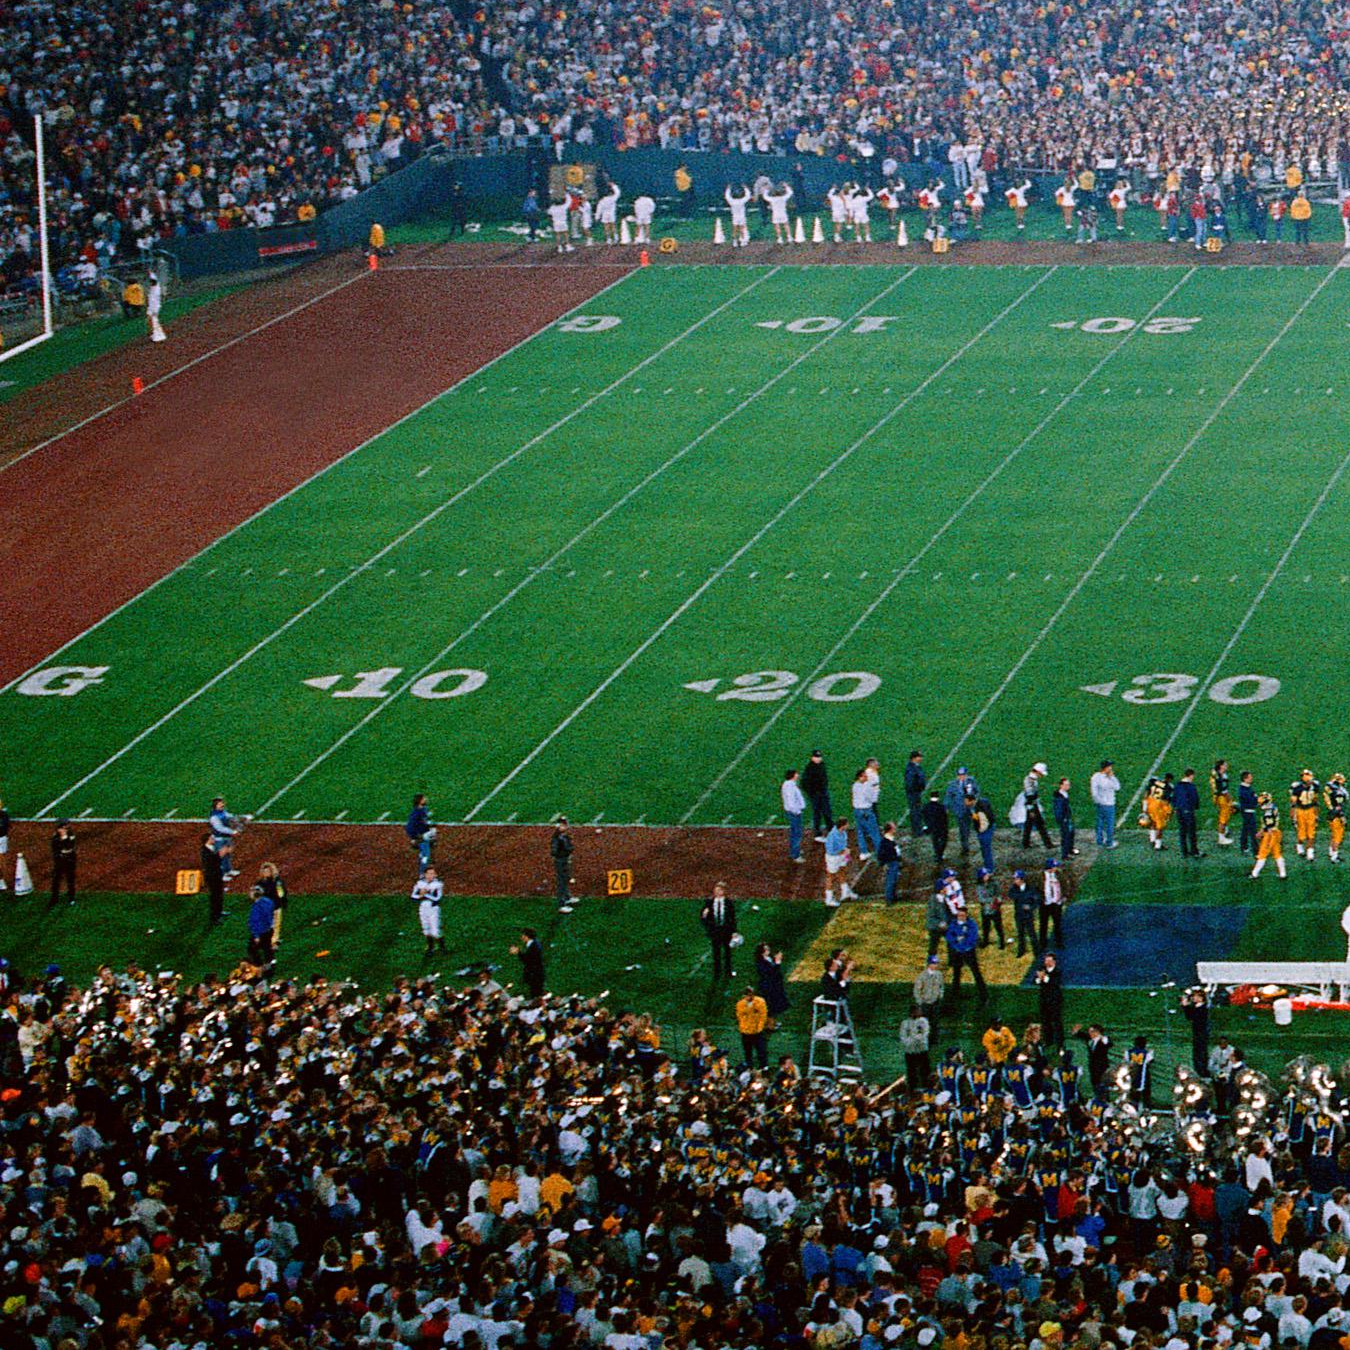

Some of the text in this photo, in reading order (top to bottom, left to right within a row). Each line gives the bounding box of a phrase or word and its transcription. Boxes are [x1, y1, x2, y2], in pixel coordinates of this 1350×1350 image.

[555, 315, 621, 333] G
[784, 316, 899, 334] 10
[1080, 317, 1202, 334] 20
[16, 666, 110, 696] G
[331, 667, 488, 699] 10
[715, 670, 882, 702] 20
[1120, 673, 1281, 705] 30
[1131, 1053, 1144, 1065] M
[942, 1066, 954, 1078] M
[973, 1071, 986, 1084] M
[1008, 1070, 1020, 1082] M
[1062, 1070, 1075, 1083] M
[928, 1173, 940, 1185] M
[1042, 1173, 1057, 1186] M
